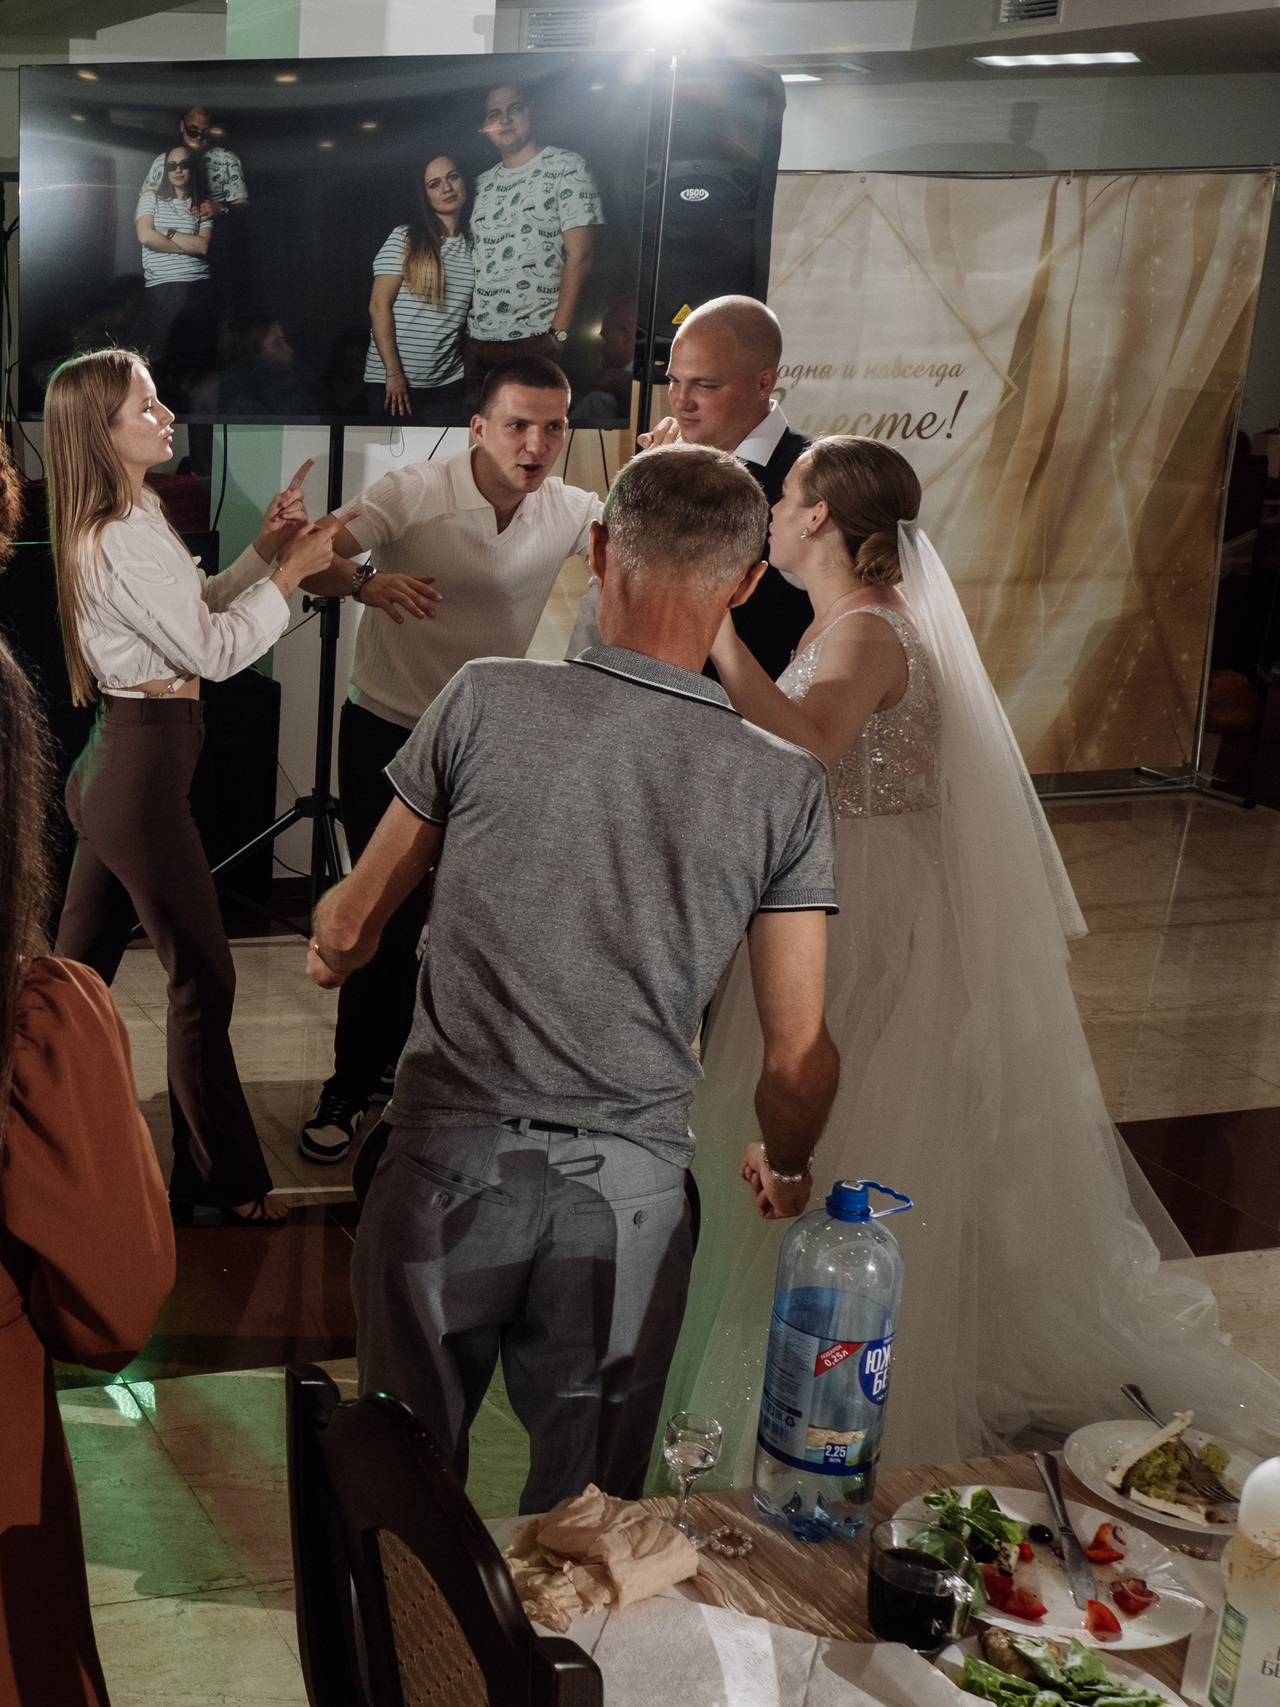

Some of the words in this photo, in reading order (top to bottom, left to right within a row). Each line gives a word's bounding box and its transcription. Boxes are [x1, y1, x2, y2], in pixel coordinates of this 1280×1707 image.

[686, 188, 705, 197] 1500
[777, 364, 835, 388] одня
[842, 363, 859, 379] и
[863, 354, 967, 388] навсегда
[865, 1344, 891, 1374] ЮЖ
[872, 1367, 888, 1396] БЕ
[1261, 1660, 1280, 1679] БЕ
